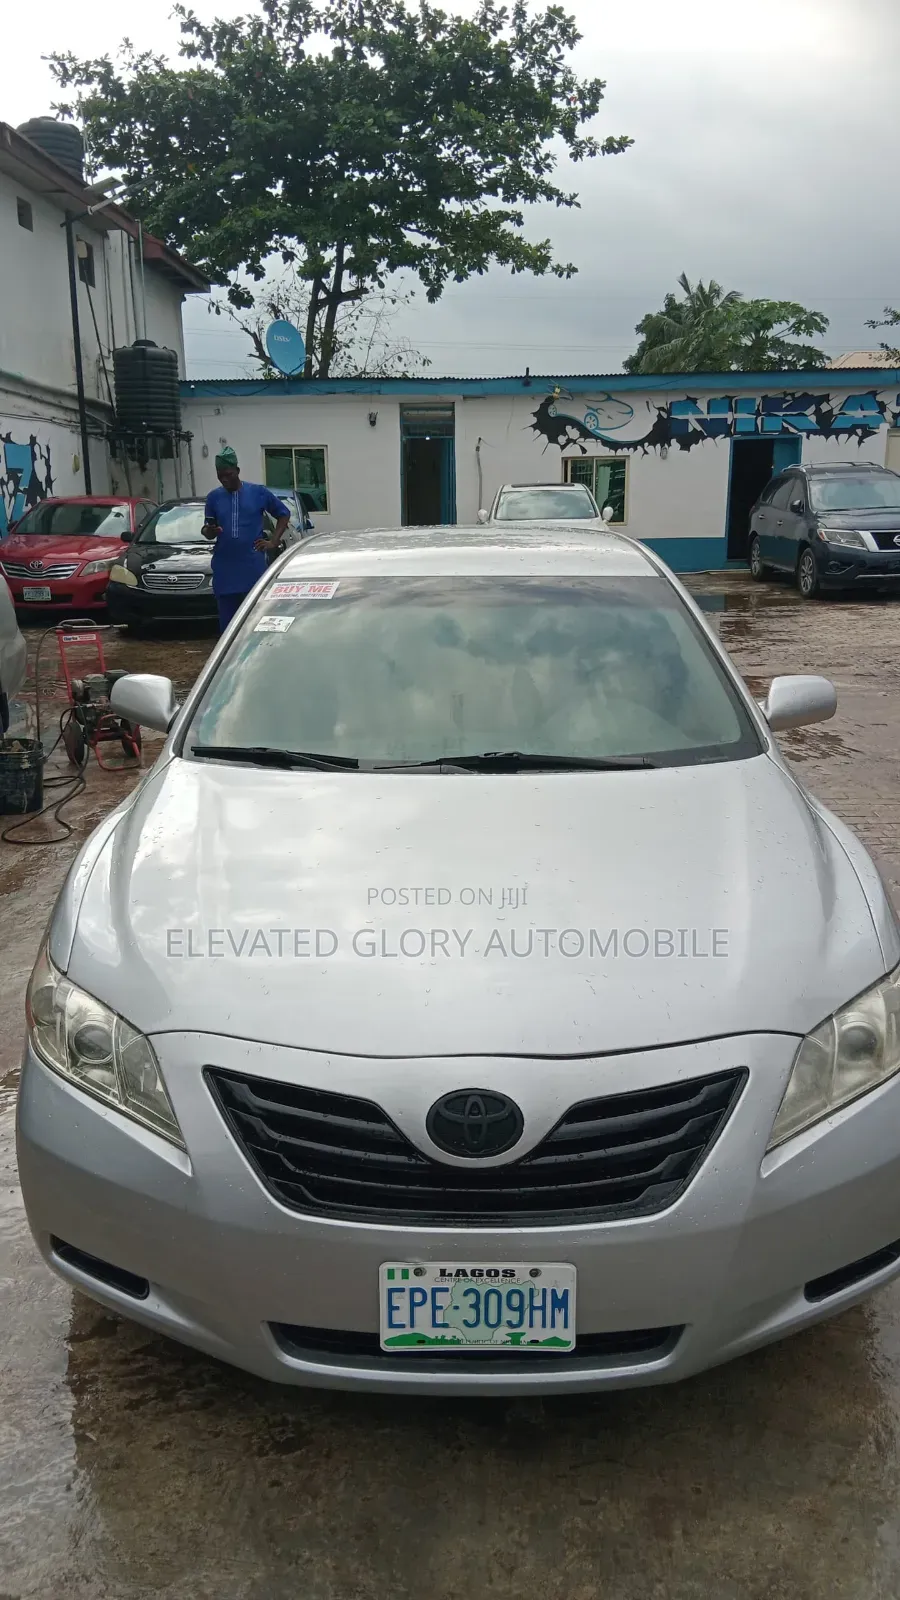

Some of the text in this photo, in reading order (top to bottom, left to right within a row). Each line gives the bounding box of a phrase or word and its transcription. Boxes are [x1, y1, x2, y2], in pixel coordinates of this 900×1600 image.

[669, 394, 900, 436] NIKA
[273, 585, 333, 594] BUY ME
[439, 1268, 516, 1278] LAGOS
[387, 1287, 569, 1329] EPE-309HM
